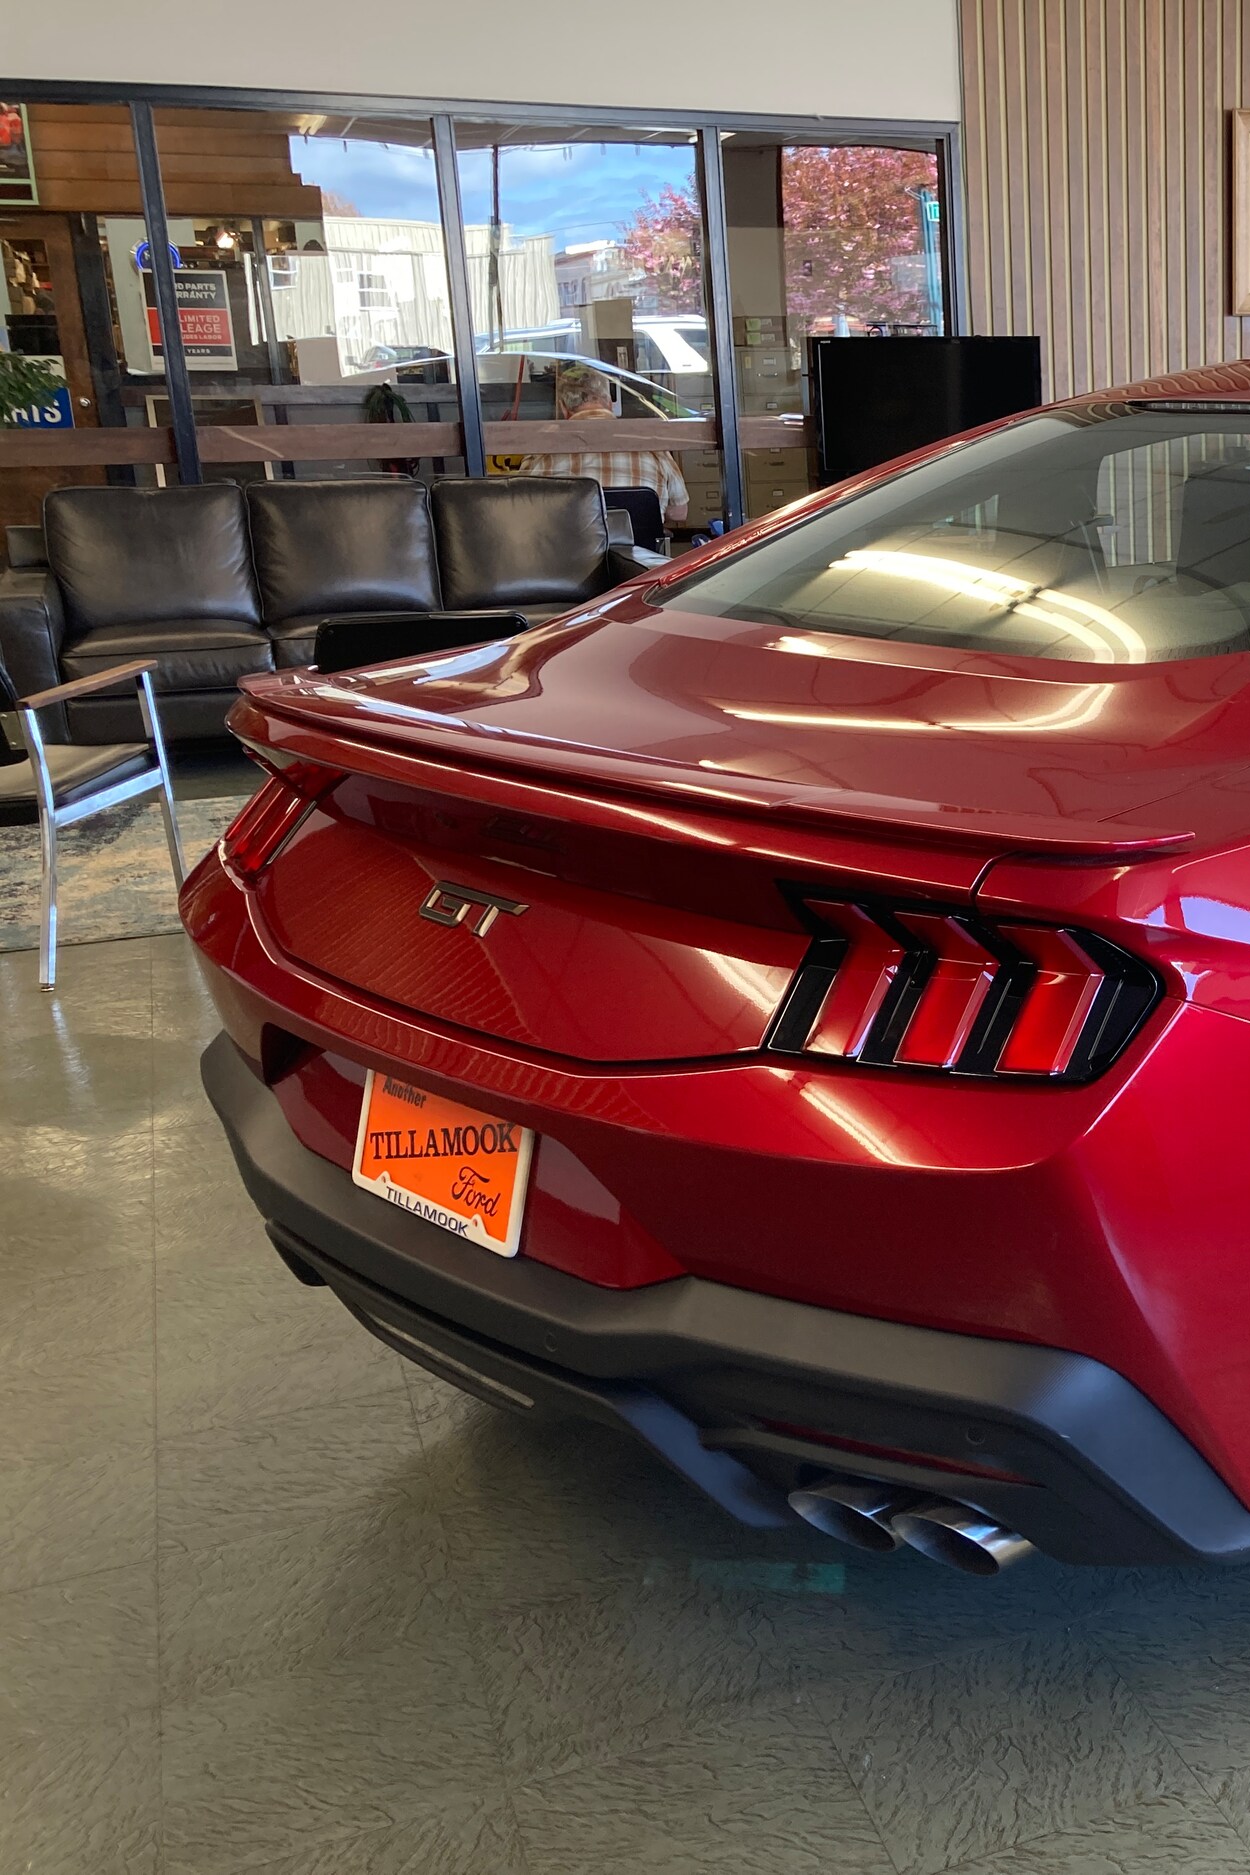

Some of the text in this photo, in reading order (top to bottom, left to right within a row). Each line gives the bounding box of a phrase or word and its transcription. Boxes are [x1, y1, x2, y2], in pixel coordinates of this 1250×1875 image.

[176, 290, 217, 299] RRANTY
[185, 283, 216, 291] PARTS
[179, 314, 220, 323] LIMITED
[180, 323, 222, 334] LEAGE
[419, 880, 530, 938] GT
[382, 1075, 427, 1109] Another
[369, 1122, 518, 1160] TILLAMOOK
[451, 1166, 502, 1217] Ford
[385, 1185, 470, 1238] TILLAMOOK
